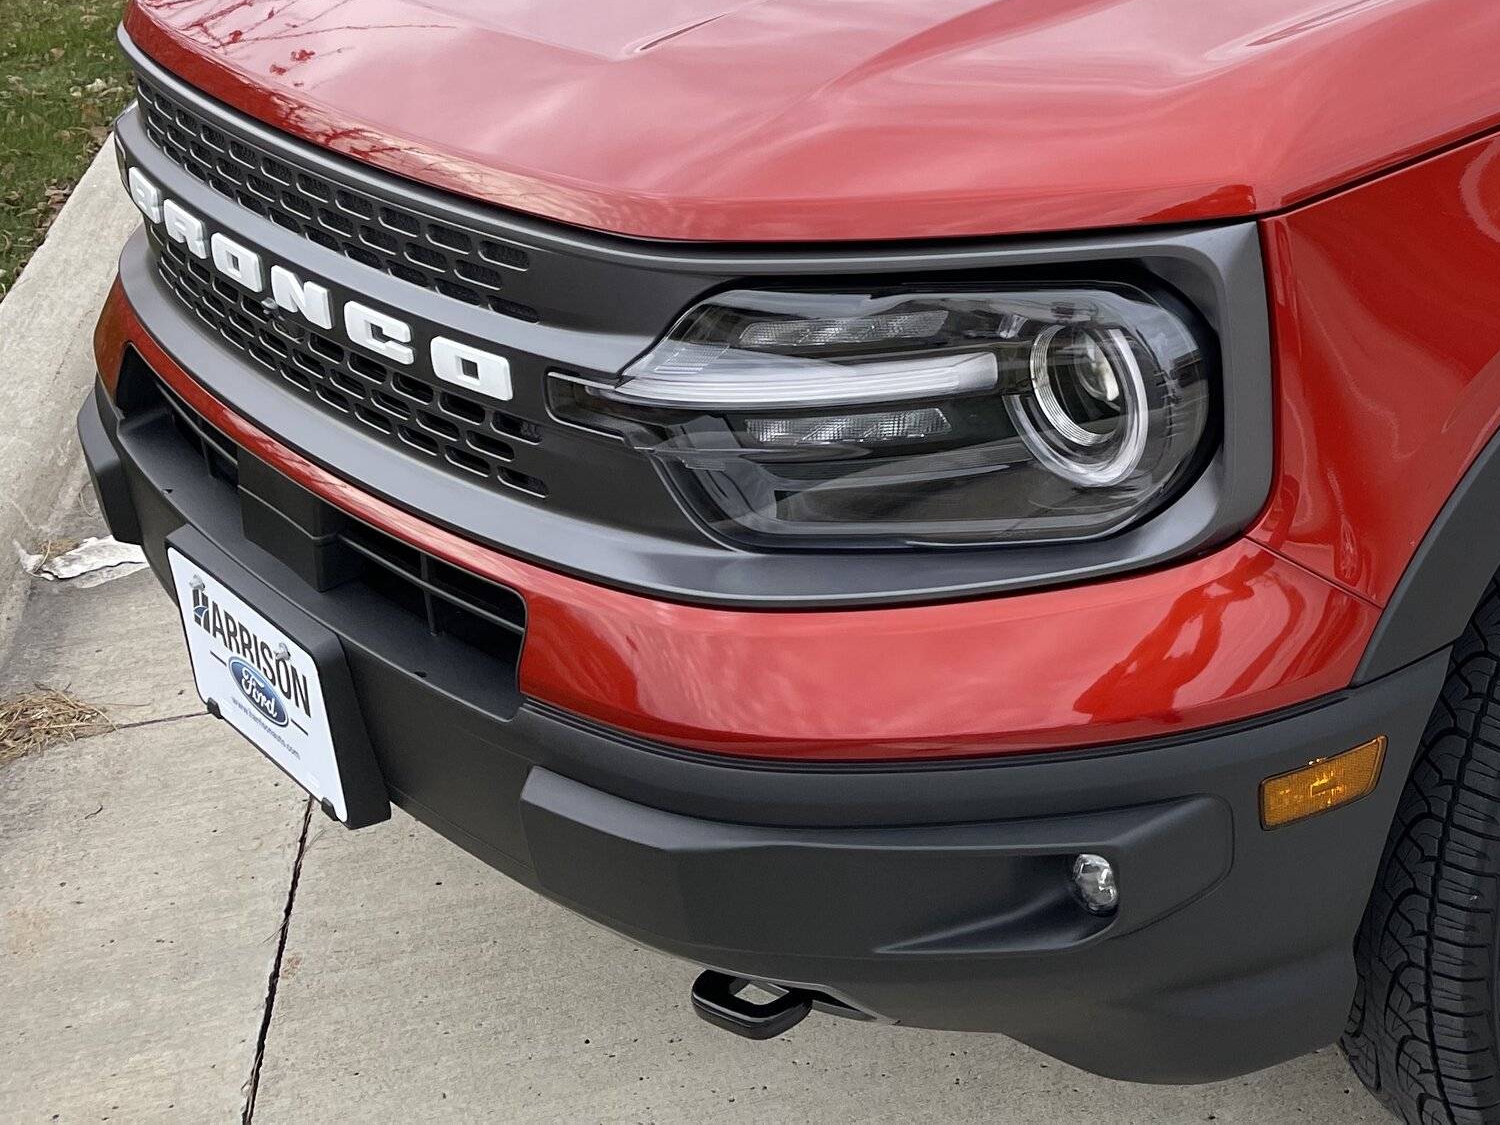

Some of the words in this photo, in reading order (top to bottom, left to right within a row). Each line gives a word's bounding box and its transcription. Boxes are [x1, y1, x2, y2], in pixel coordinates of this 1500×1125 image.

[128, 166, 514, 401] BRONCO
[192, 588, 312, 718] HARRISON
[241, 666, 278, 719] Ford
